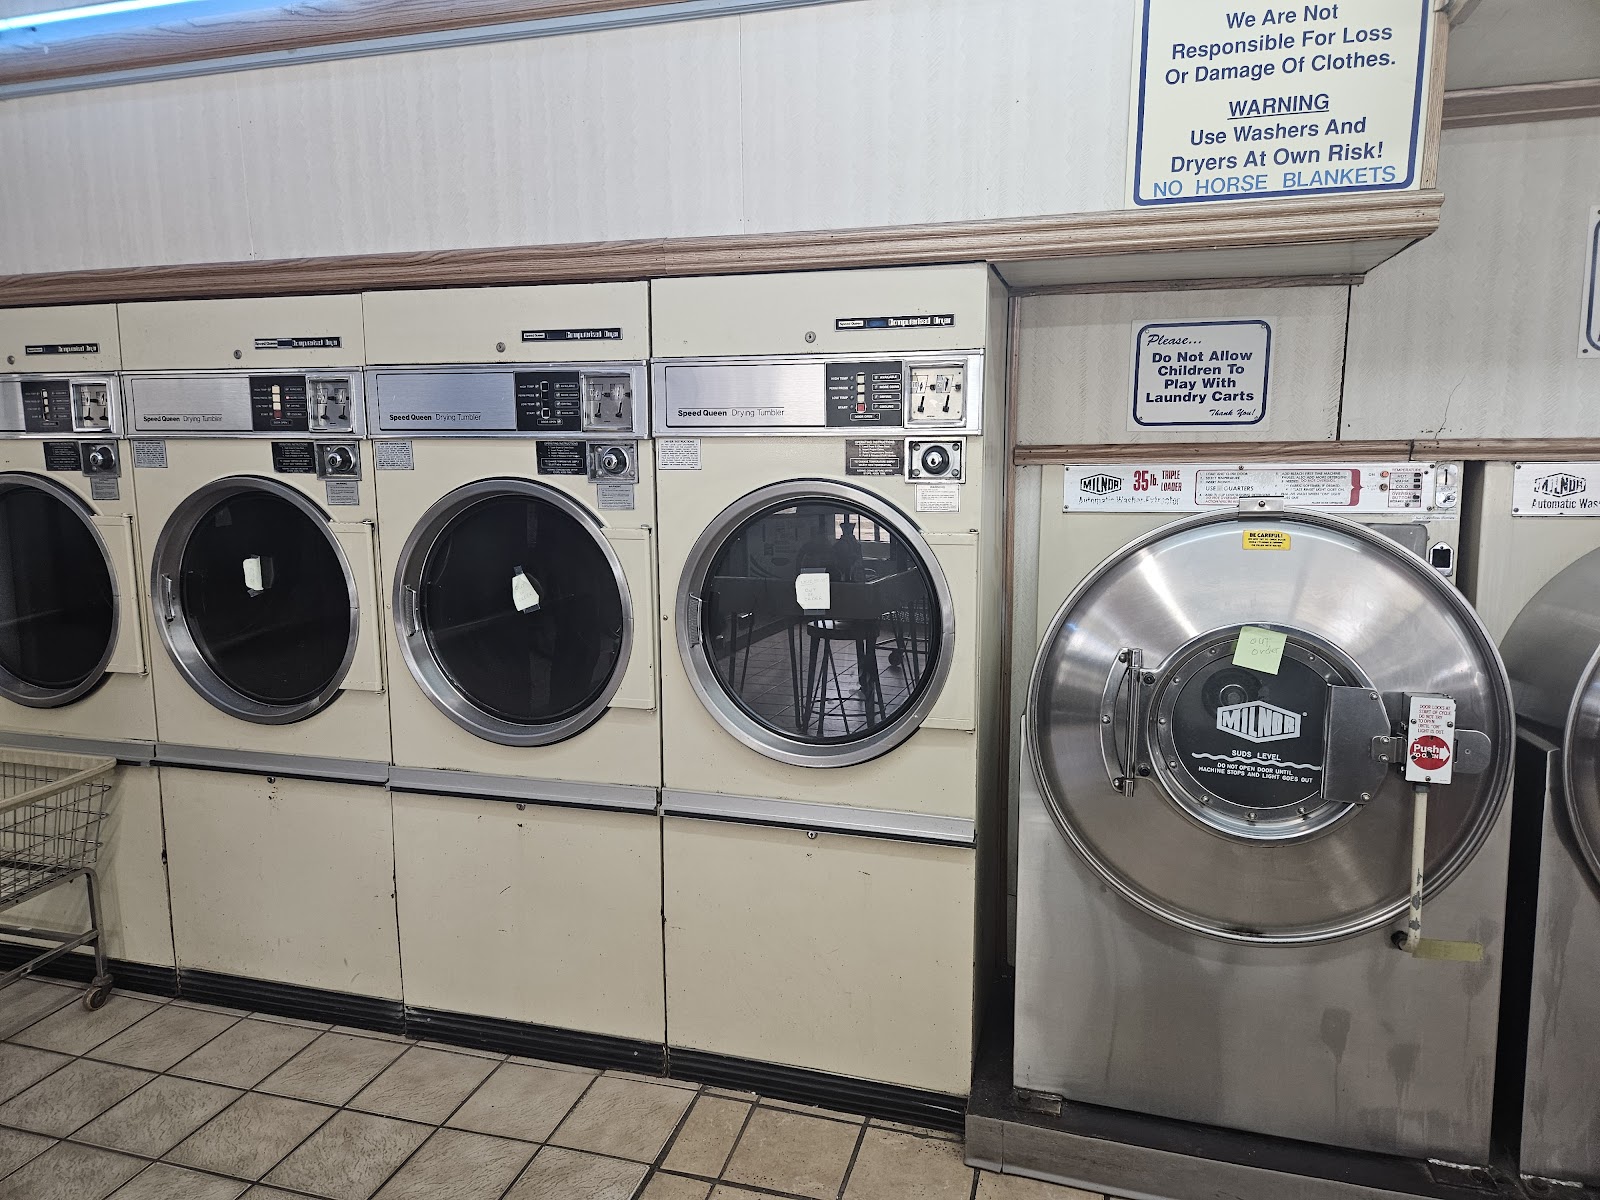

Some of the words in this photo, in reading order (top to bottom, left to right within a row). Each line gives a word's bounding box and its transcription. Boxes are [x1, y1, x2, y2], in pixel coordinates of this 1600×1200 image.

[1226, 12, 1256, 29] We
[1261, 9, 1297, 26] Are
[1303, 4, 1339, 22] Not
[1172, 33, 1295, 60] Responsible
[1302, 30, 1336, 48] For
[1343, 27, 1393, 44] Loss
[1165, 68, 1189, 85] Or
[1195, 61, 1275, 82] Damage
[1282, 57, 1306, 74] Of
[1312, 51, 1396, 71] Clothes.
[1228, 93, 1330, 118] WARNING
[1190, 128, 1227, 146] Use
[1233, 122, 1319, 142] Washers
[1325, 116, 1367, 135] And
[1171, 153, 1238, 176] Dryers
[1243, 150, 1266, 168] At
[1273, 147, 1321, 166] Own
[1328, 141, 1384, 162] Risk!
[1153, 180, 1183, 198] NO
[1195, 174, 1268, 195] HORSE
[1282, 165, 1397, 189] BLANKETS
[1147, 334, 1202, 346] Please...
[1152, 352, 1172, 363] Do
[1177, 351, 1204, 362] Not
[1208, 350, 1252, 361] Allow
[1158, 365, 1222, 376] Children
[1227, 364, 1244, 374] To
[1164, 378, 1197, 390] Play
[1202, 378, 1236, 388] With
[1146, 392, 1207, 404] Laundry
[1212, 391, 1254, 402] Carts
[435, 413, 456, 422] Drying
[678, 410, 702, 418] Speed
[732, 408, 754, 418] Drying
[757, 408, 784, 416] Tumbler
[1236, 408, 1256, 418] You!
[1134, 470, 1149, 491] 35
[1150, 474, 1158, 486] lb.
[1162, 470, 1181, 480] TRIPLE
[1083, 476, 1120, 492] MILNOR
[1160, 482, 1182, 492] LOADER
[1532, 498, 1577, 508] Automatic
[1222, 706, 1296, 738] MILNOR
[1414, 743, 1440, 754] Push
[1232, 749, 1252, 758] SUDS
[1257, 752, 1282, 761] LEVEL
[1198, 766, 1226, 774] MACHINE
